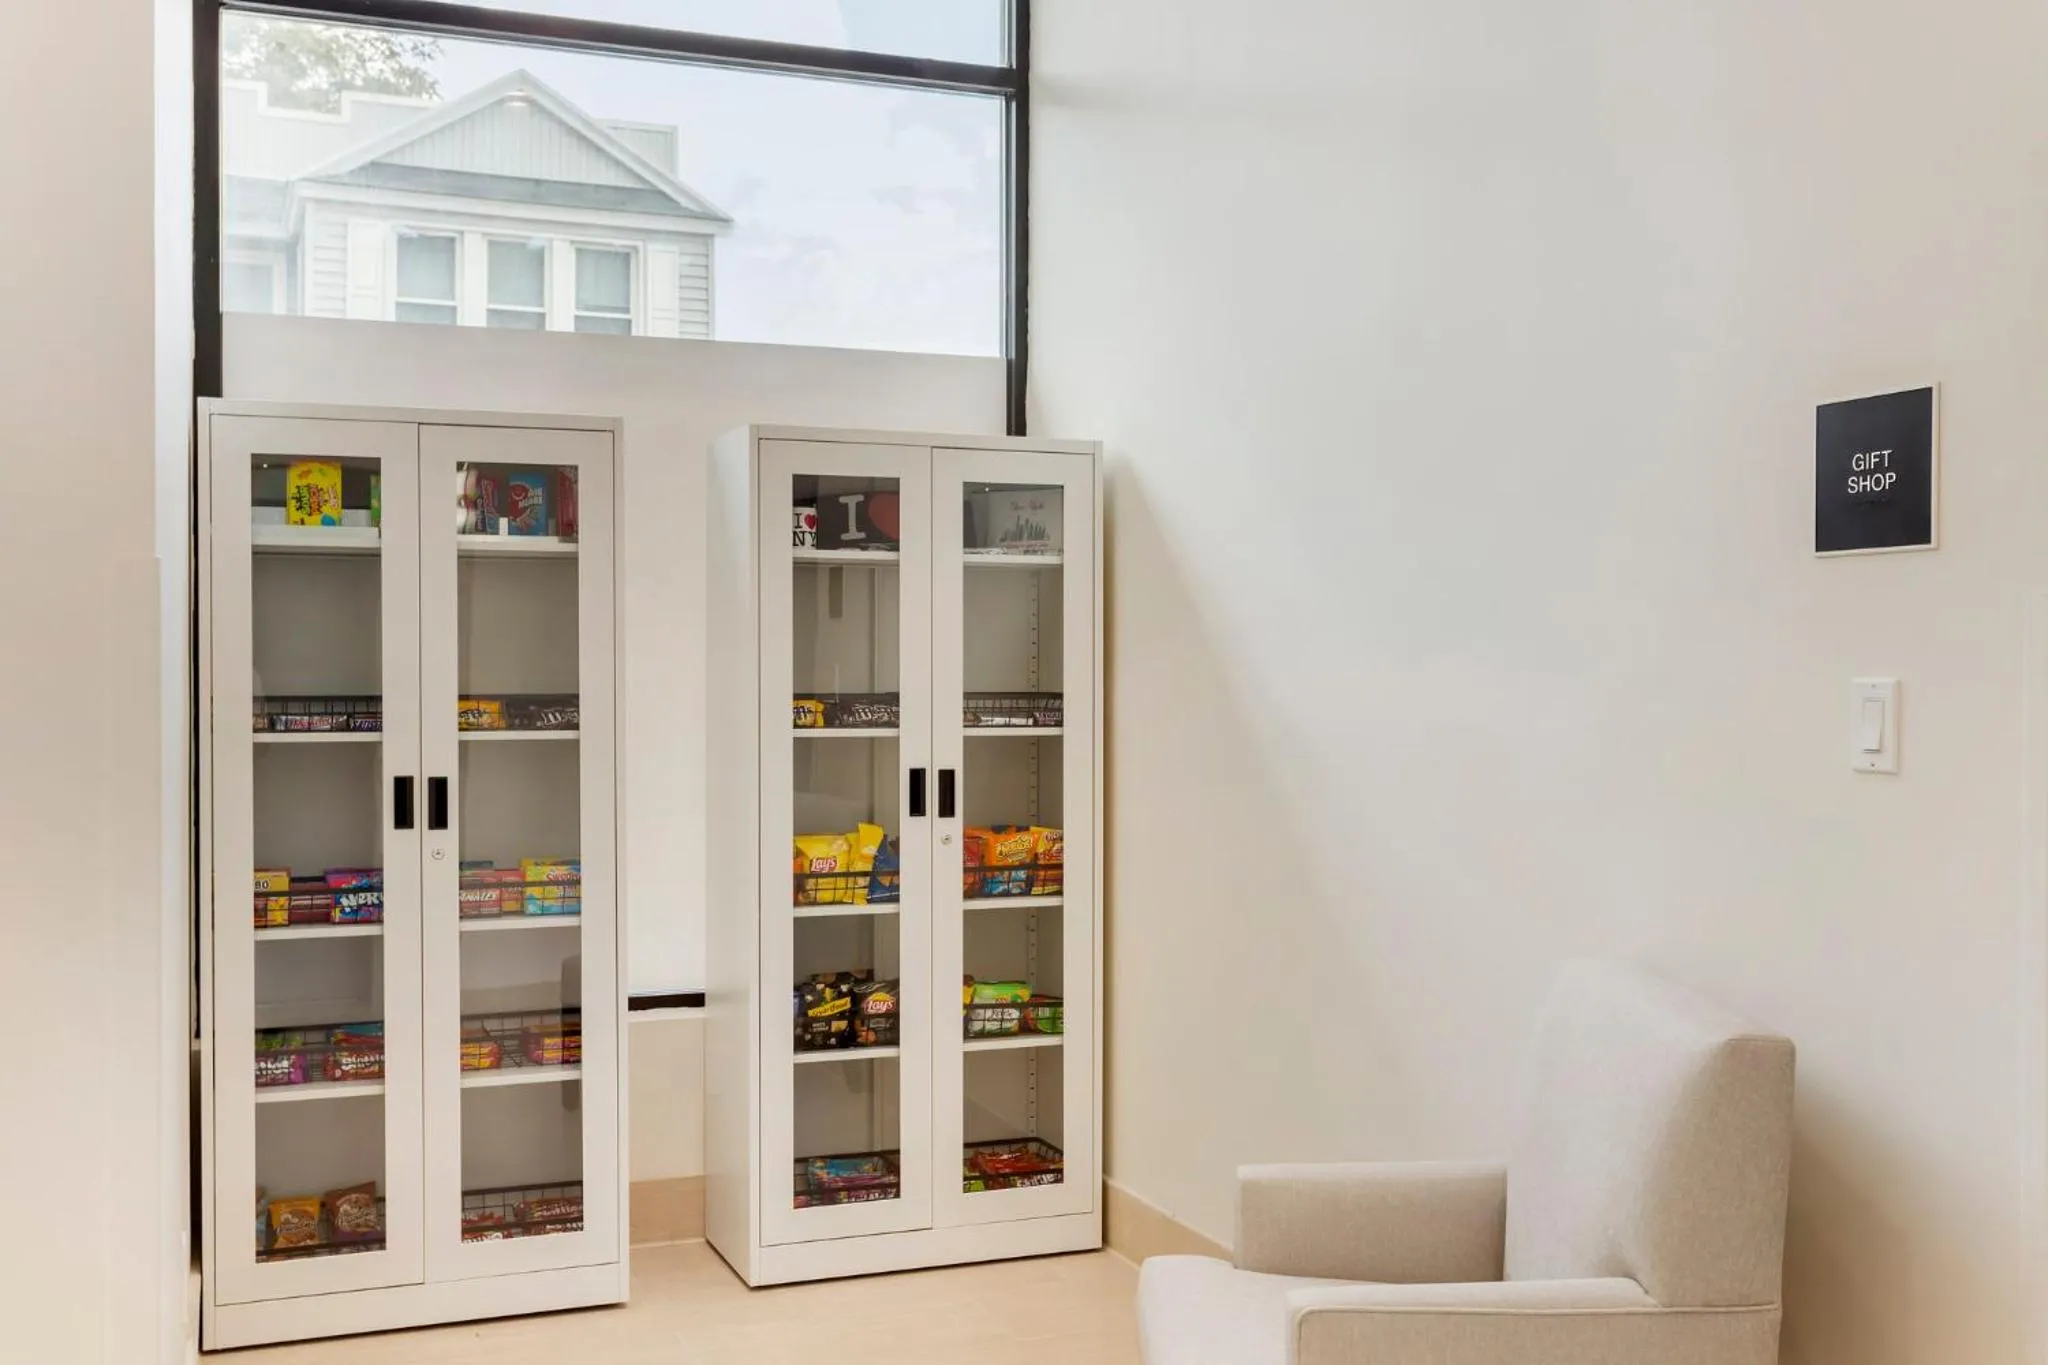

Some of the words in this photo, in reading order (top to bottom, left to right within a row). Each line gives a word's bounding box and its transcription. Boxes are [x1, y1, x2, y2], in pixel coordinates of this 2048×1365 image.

[1852, 450, 1892, 471] GIFT
[1847, 472, 1896, 494] SHOP
[793, 513, 803, 529] I
[838, 494, 867, 540] I
